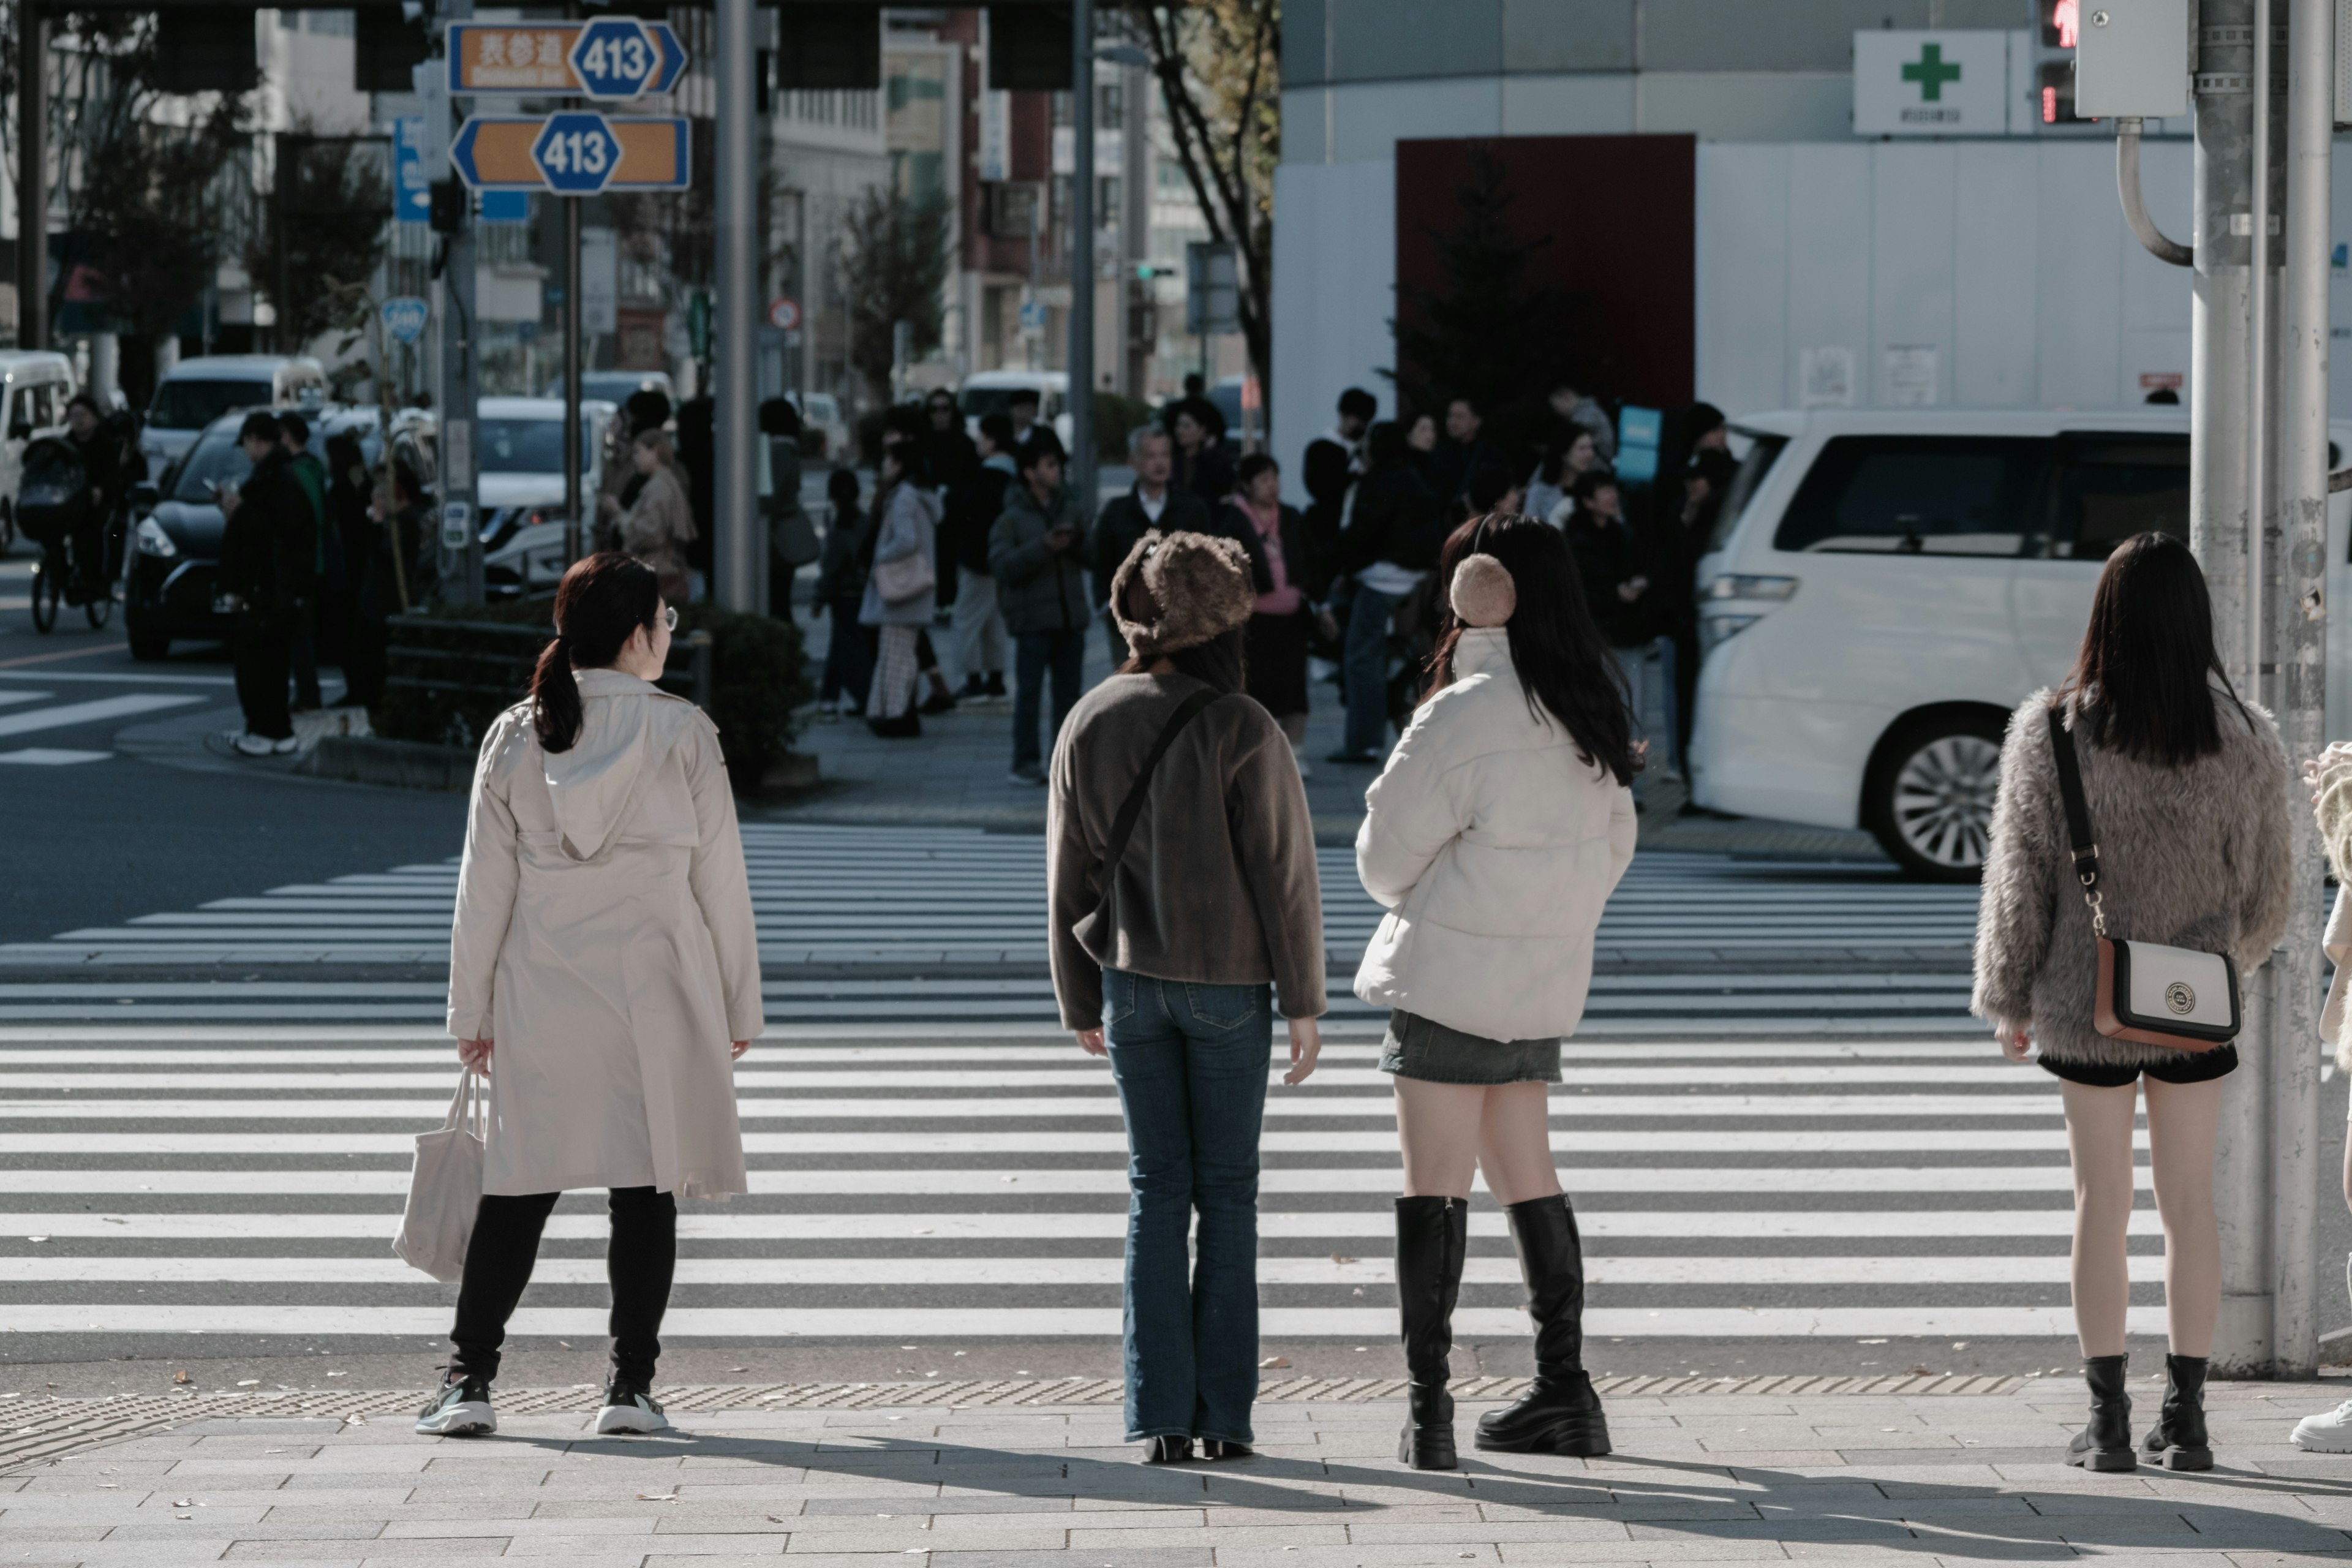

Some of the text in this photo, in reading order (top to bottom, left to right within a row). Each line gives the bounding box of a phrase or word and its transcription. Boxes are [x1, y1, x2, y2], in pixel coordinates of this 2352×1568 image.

[480, 33, 563, 66] 表参道
[582, 37, 647, 80] 413
[543, 130, 607, 174] 413
